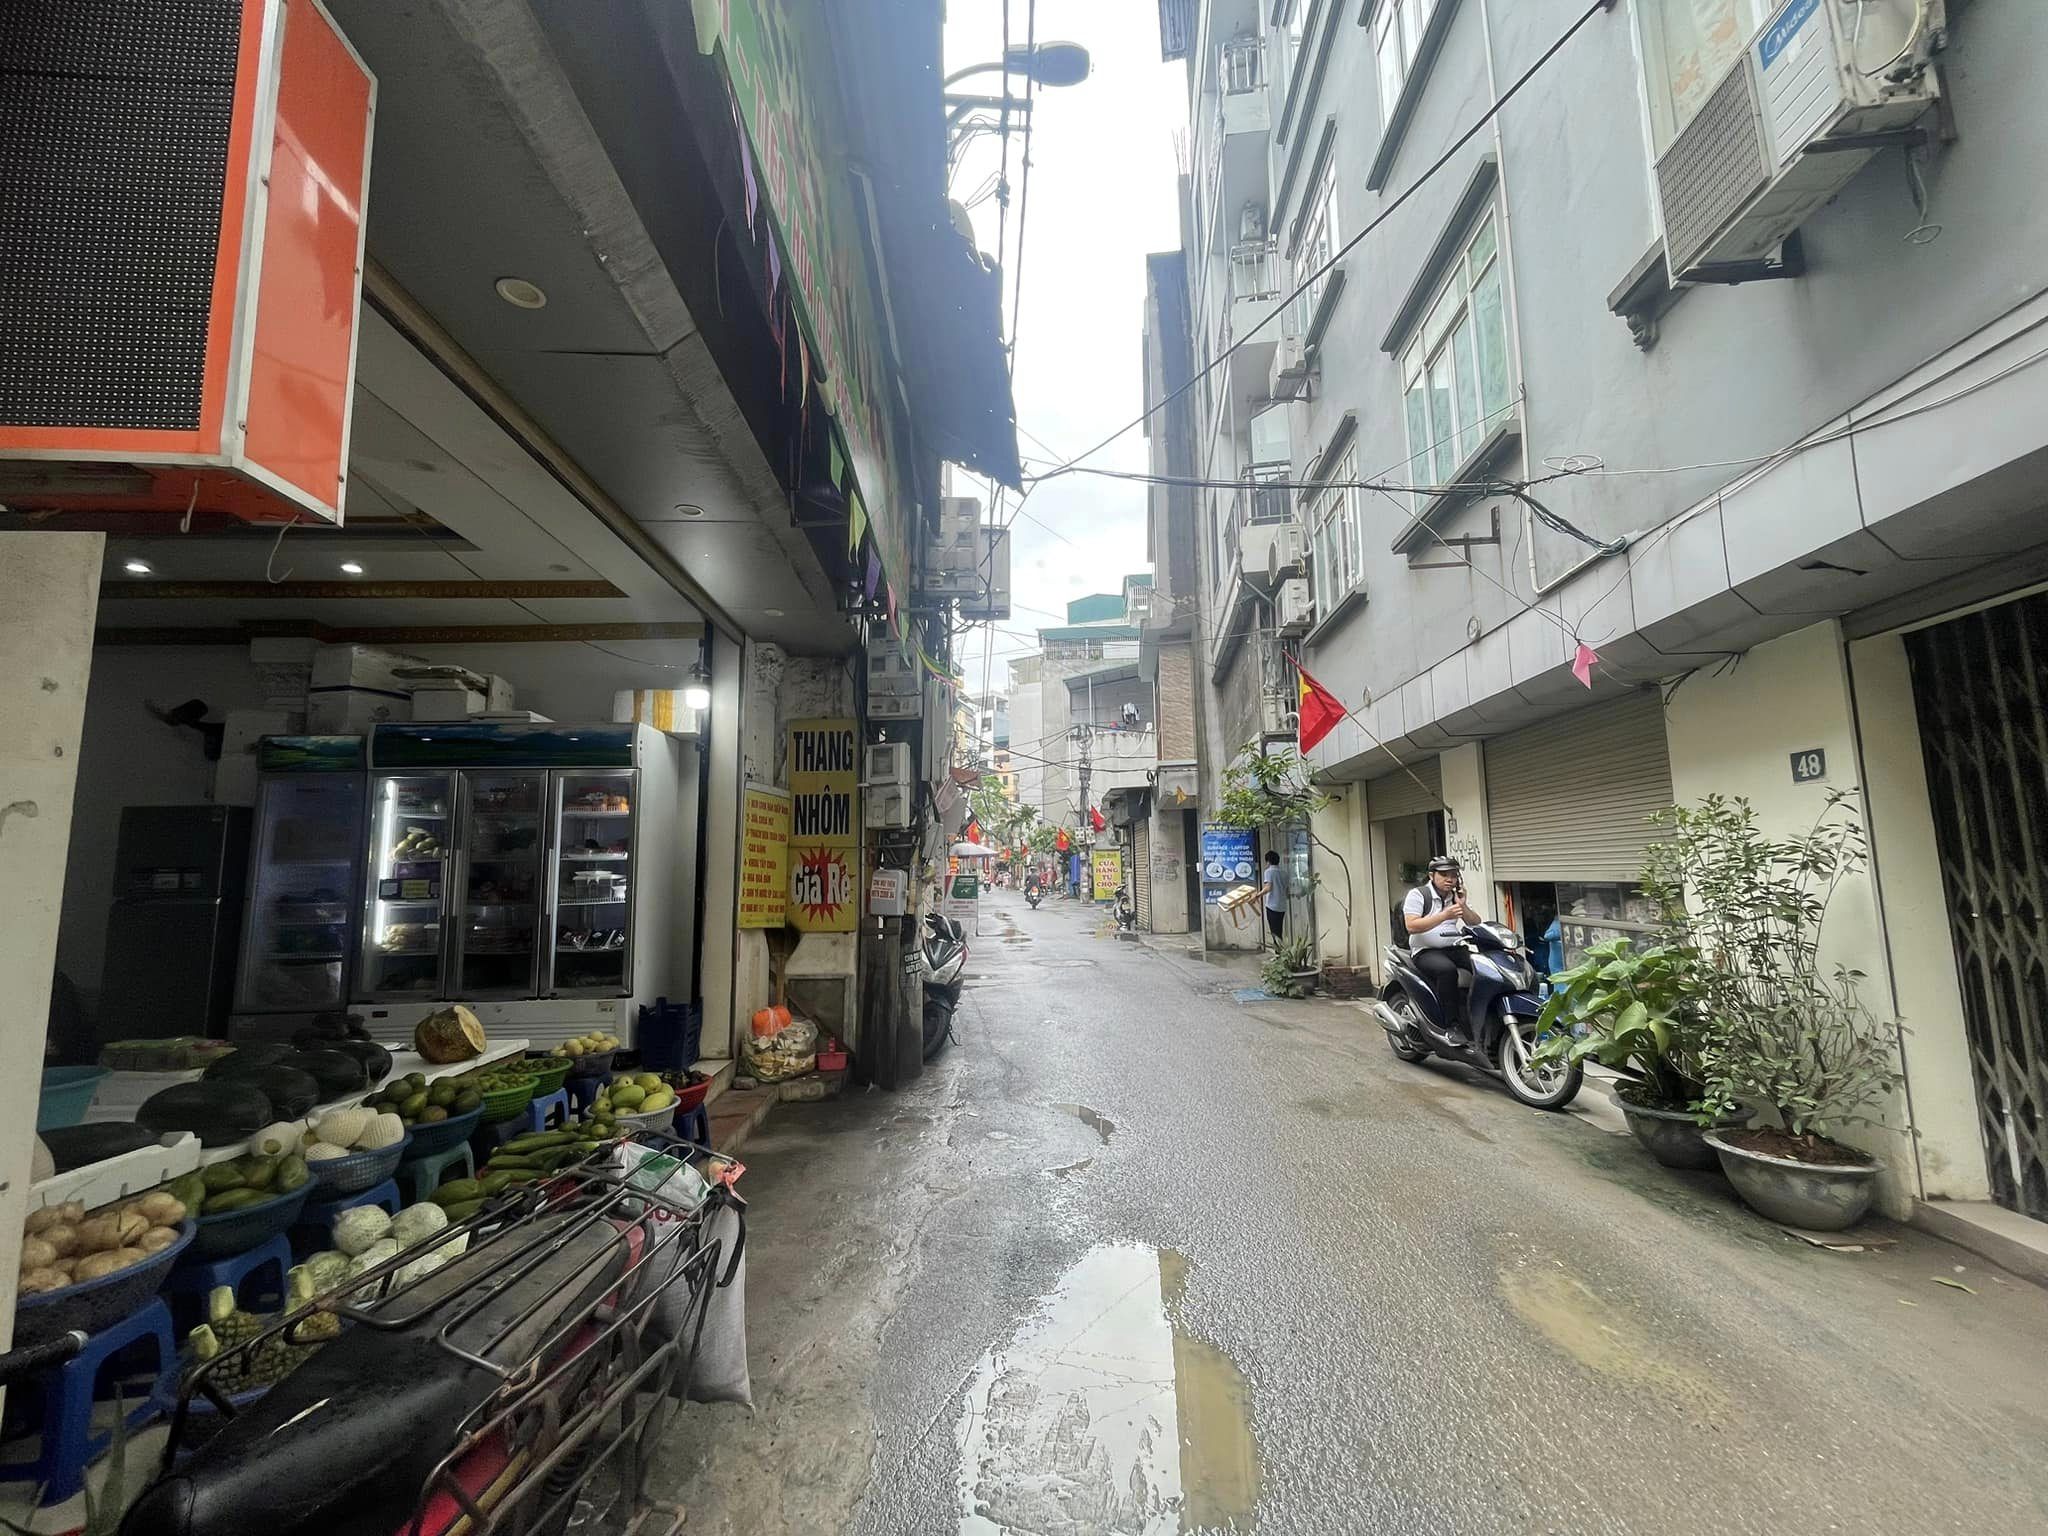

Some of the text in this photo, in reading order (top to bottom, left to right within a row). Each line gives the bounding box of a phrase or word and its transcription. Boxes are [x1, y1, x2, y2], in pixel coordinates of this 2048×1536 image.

[793, 730, 854, 772] THANG
[1798, 753, 1821, 777] 48
[795, 785, 850, 835] NHÔM
[791, 864, 823, 905] Giá
